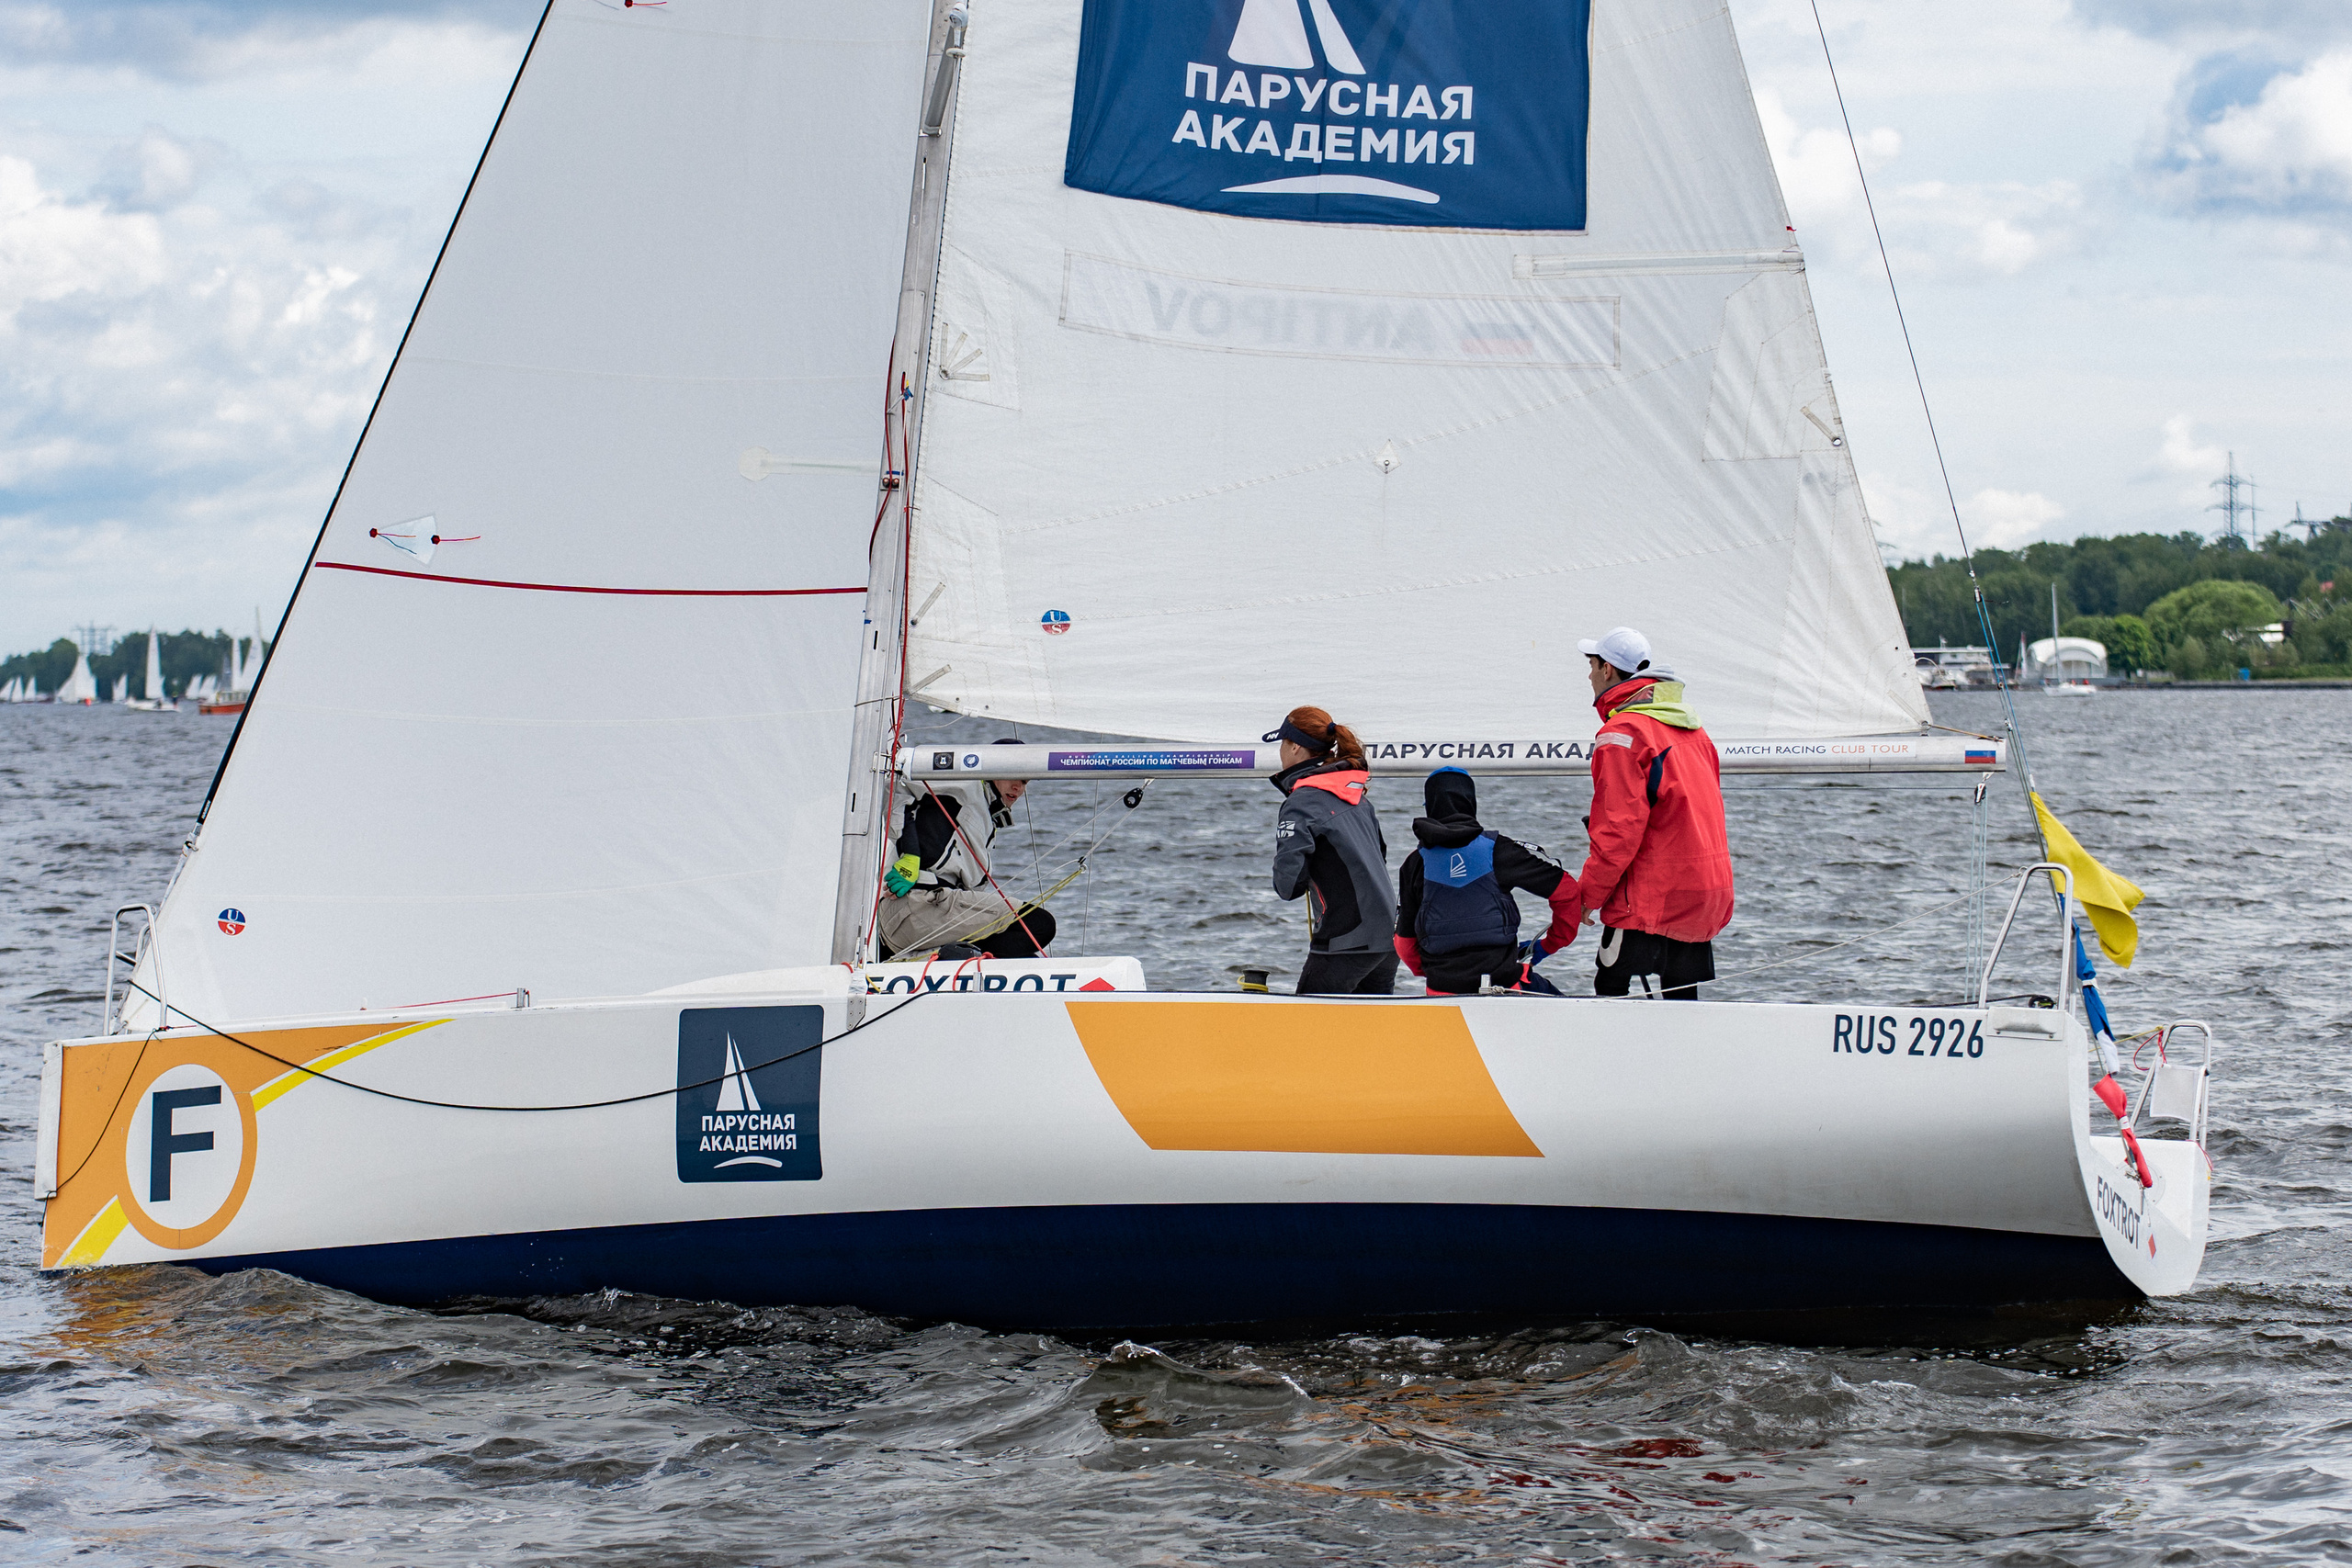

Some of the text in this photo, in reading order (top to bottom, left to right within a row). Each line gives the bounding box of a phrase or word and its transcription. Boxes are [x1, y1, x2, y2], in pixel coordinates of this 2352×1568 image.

[1185, 62, 1474, 120] ПАРУСНАЯ
[1171, 109, 1476, 165] АКАДЕМИЯ
[1060, 758, 1111, 766] ЧЕМПИОНАТ
[1112, 758, 1146, 766] РОССИИ
[1159, 757, 1207, 765] МАТЧЕВЫМ
[1363, 742, 1514, 759] ПАРУСНАЯ
[1725, 744, 1909, 755] MATCH RACING CLUB TOUR
[1833, 1014, 1984, 1058] RUS 2926
[701, 1113, 796, 1132] ПАРУСНАЯ
[149, 1085, 222, 1202] F
[698, 1134, 797, 1153] АКАДЕМИЯ
[2097, 1175, 2141, 1250] FOXTROT
